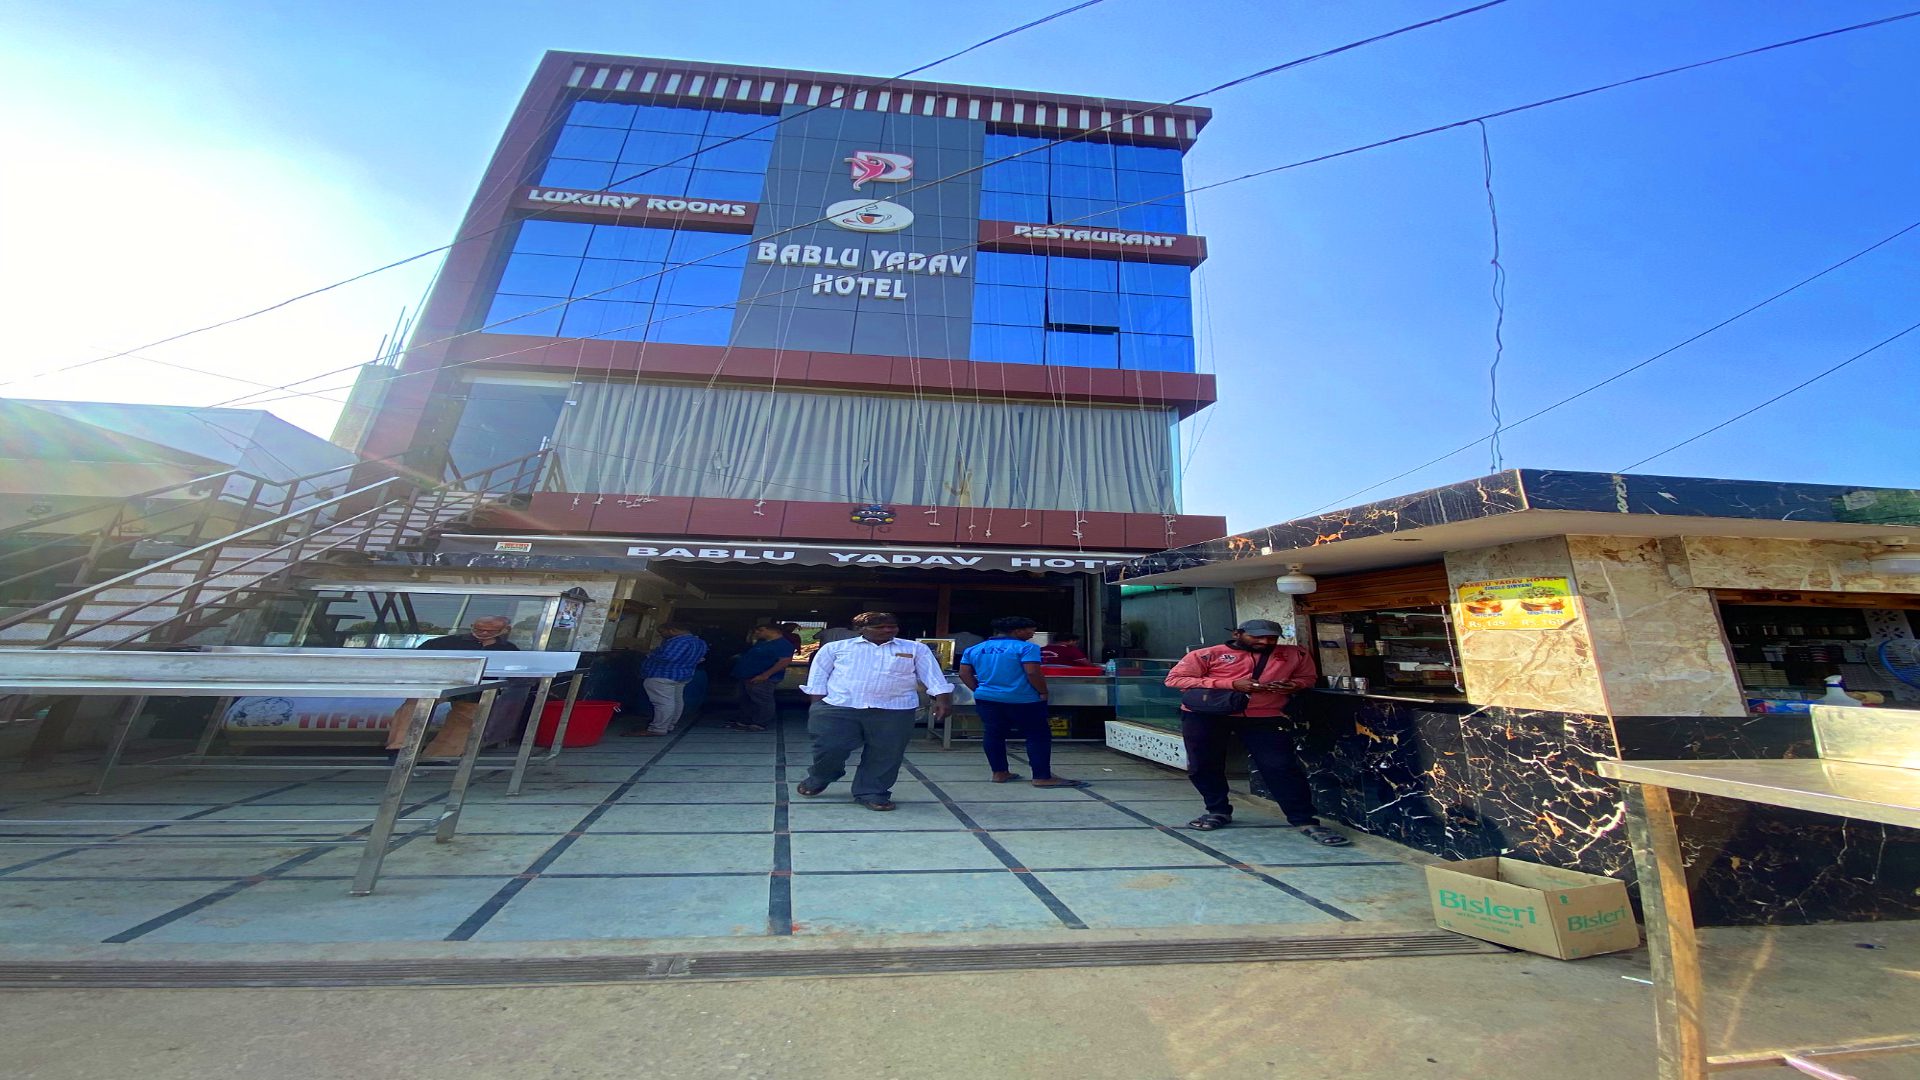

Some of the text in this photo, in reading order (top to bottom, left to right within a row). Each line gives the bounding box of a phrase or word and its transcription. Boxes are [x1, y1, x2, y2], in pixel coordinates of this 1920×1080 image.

[528, 189, 746, 216] LUXURY ROOMS
[1014, 225, 1177, 247] RESTAURANT
[757, 242, 968, 275] BABLU YADAV
[812, 273, 908, 300] HOTEL
[627, 546, 795, 561] BABLU
[828, 552, 984, 566] YADAV
[1439, 889, 1537, 925] Bisleri
[1567, 905, 1627, 932] Bisleri
